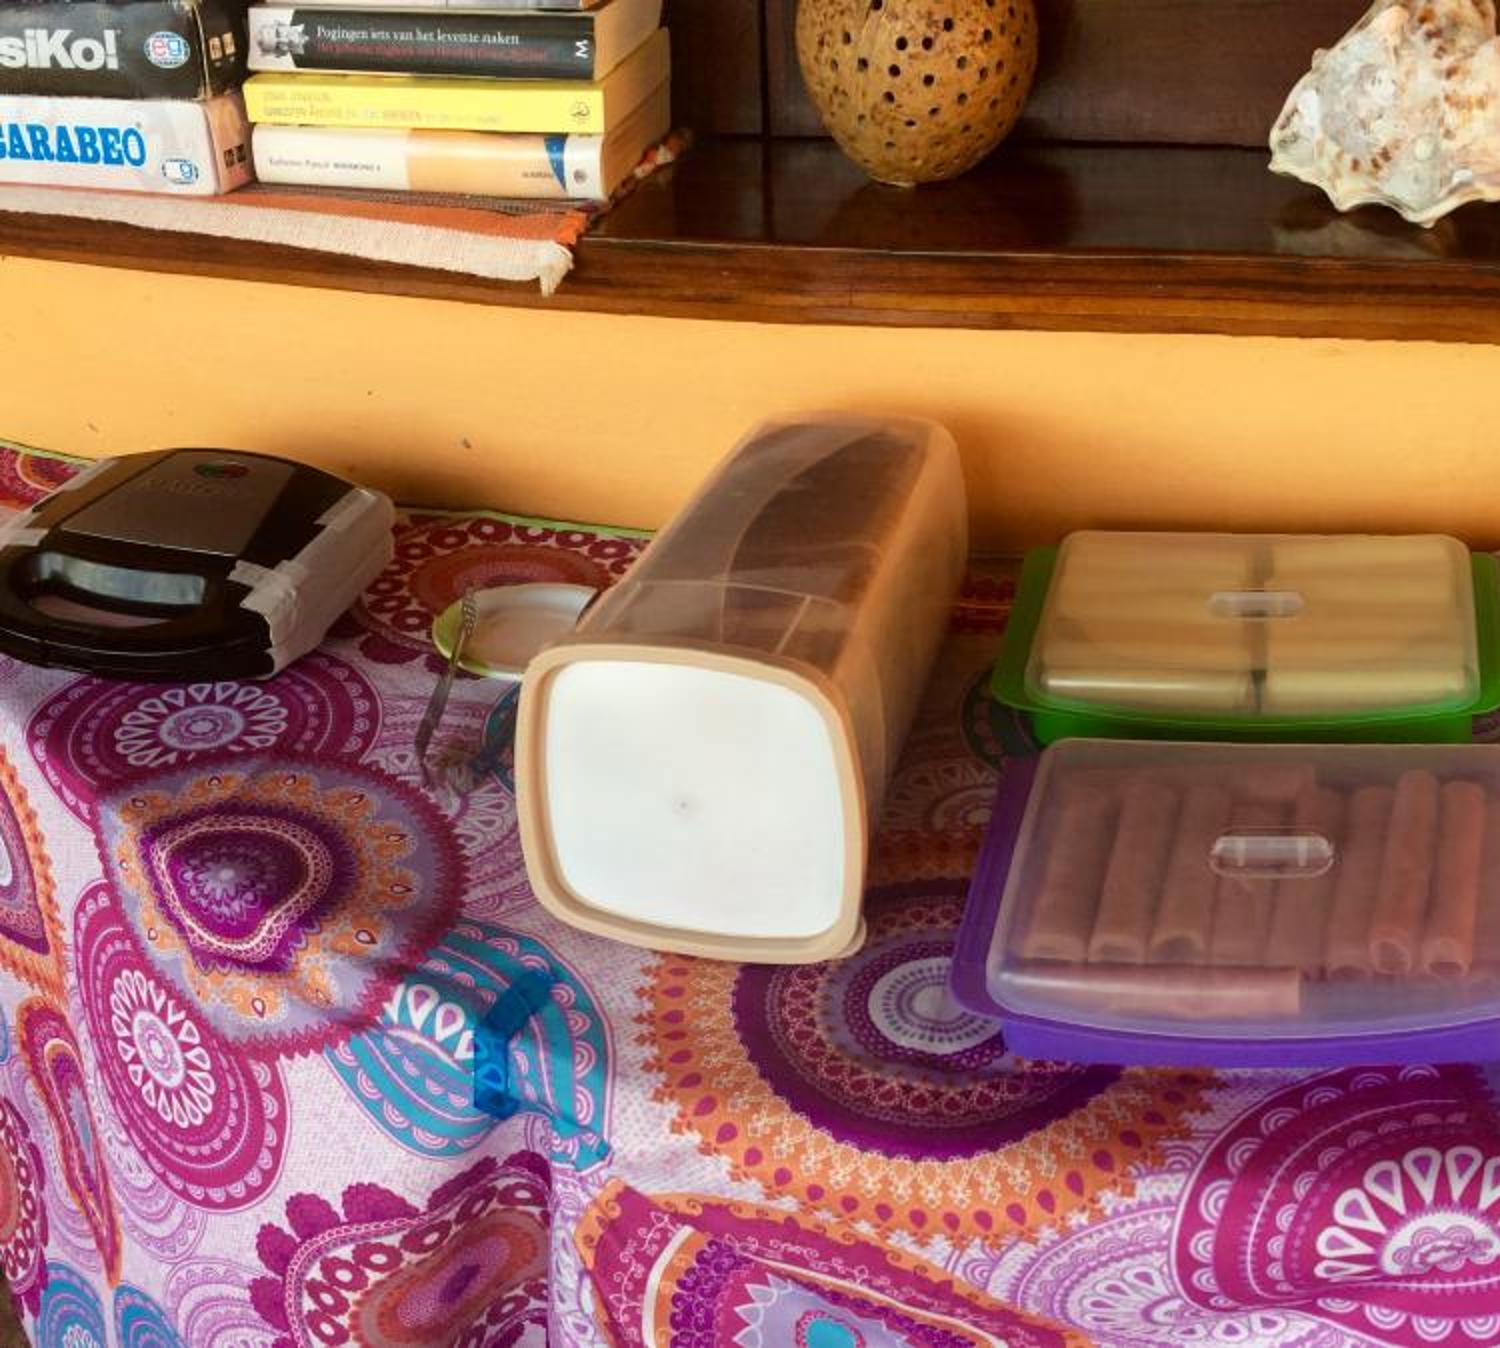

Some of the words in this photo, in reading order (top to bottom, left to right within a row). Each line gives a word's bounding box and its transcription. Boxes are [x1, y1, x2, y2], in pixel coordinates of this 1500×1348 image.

[317, 24, 369, 42] Pogingen
[391, 31, 414, 41] van
[415, 27, 435, 42] het
